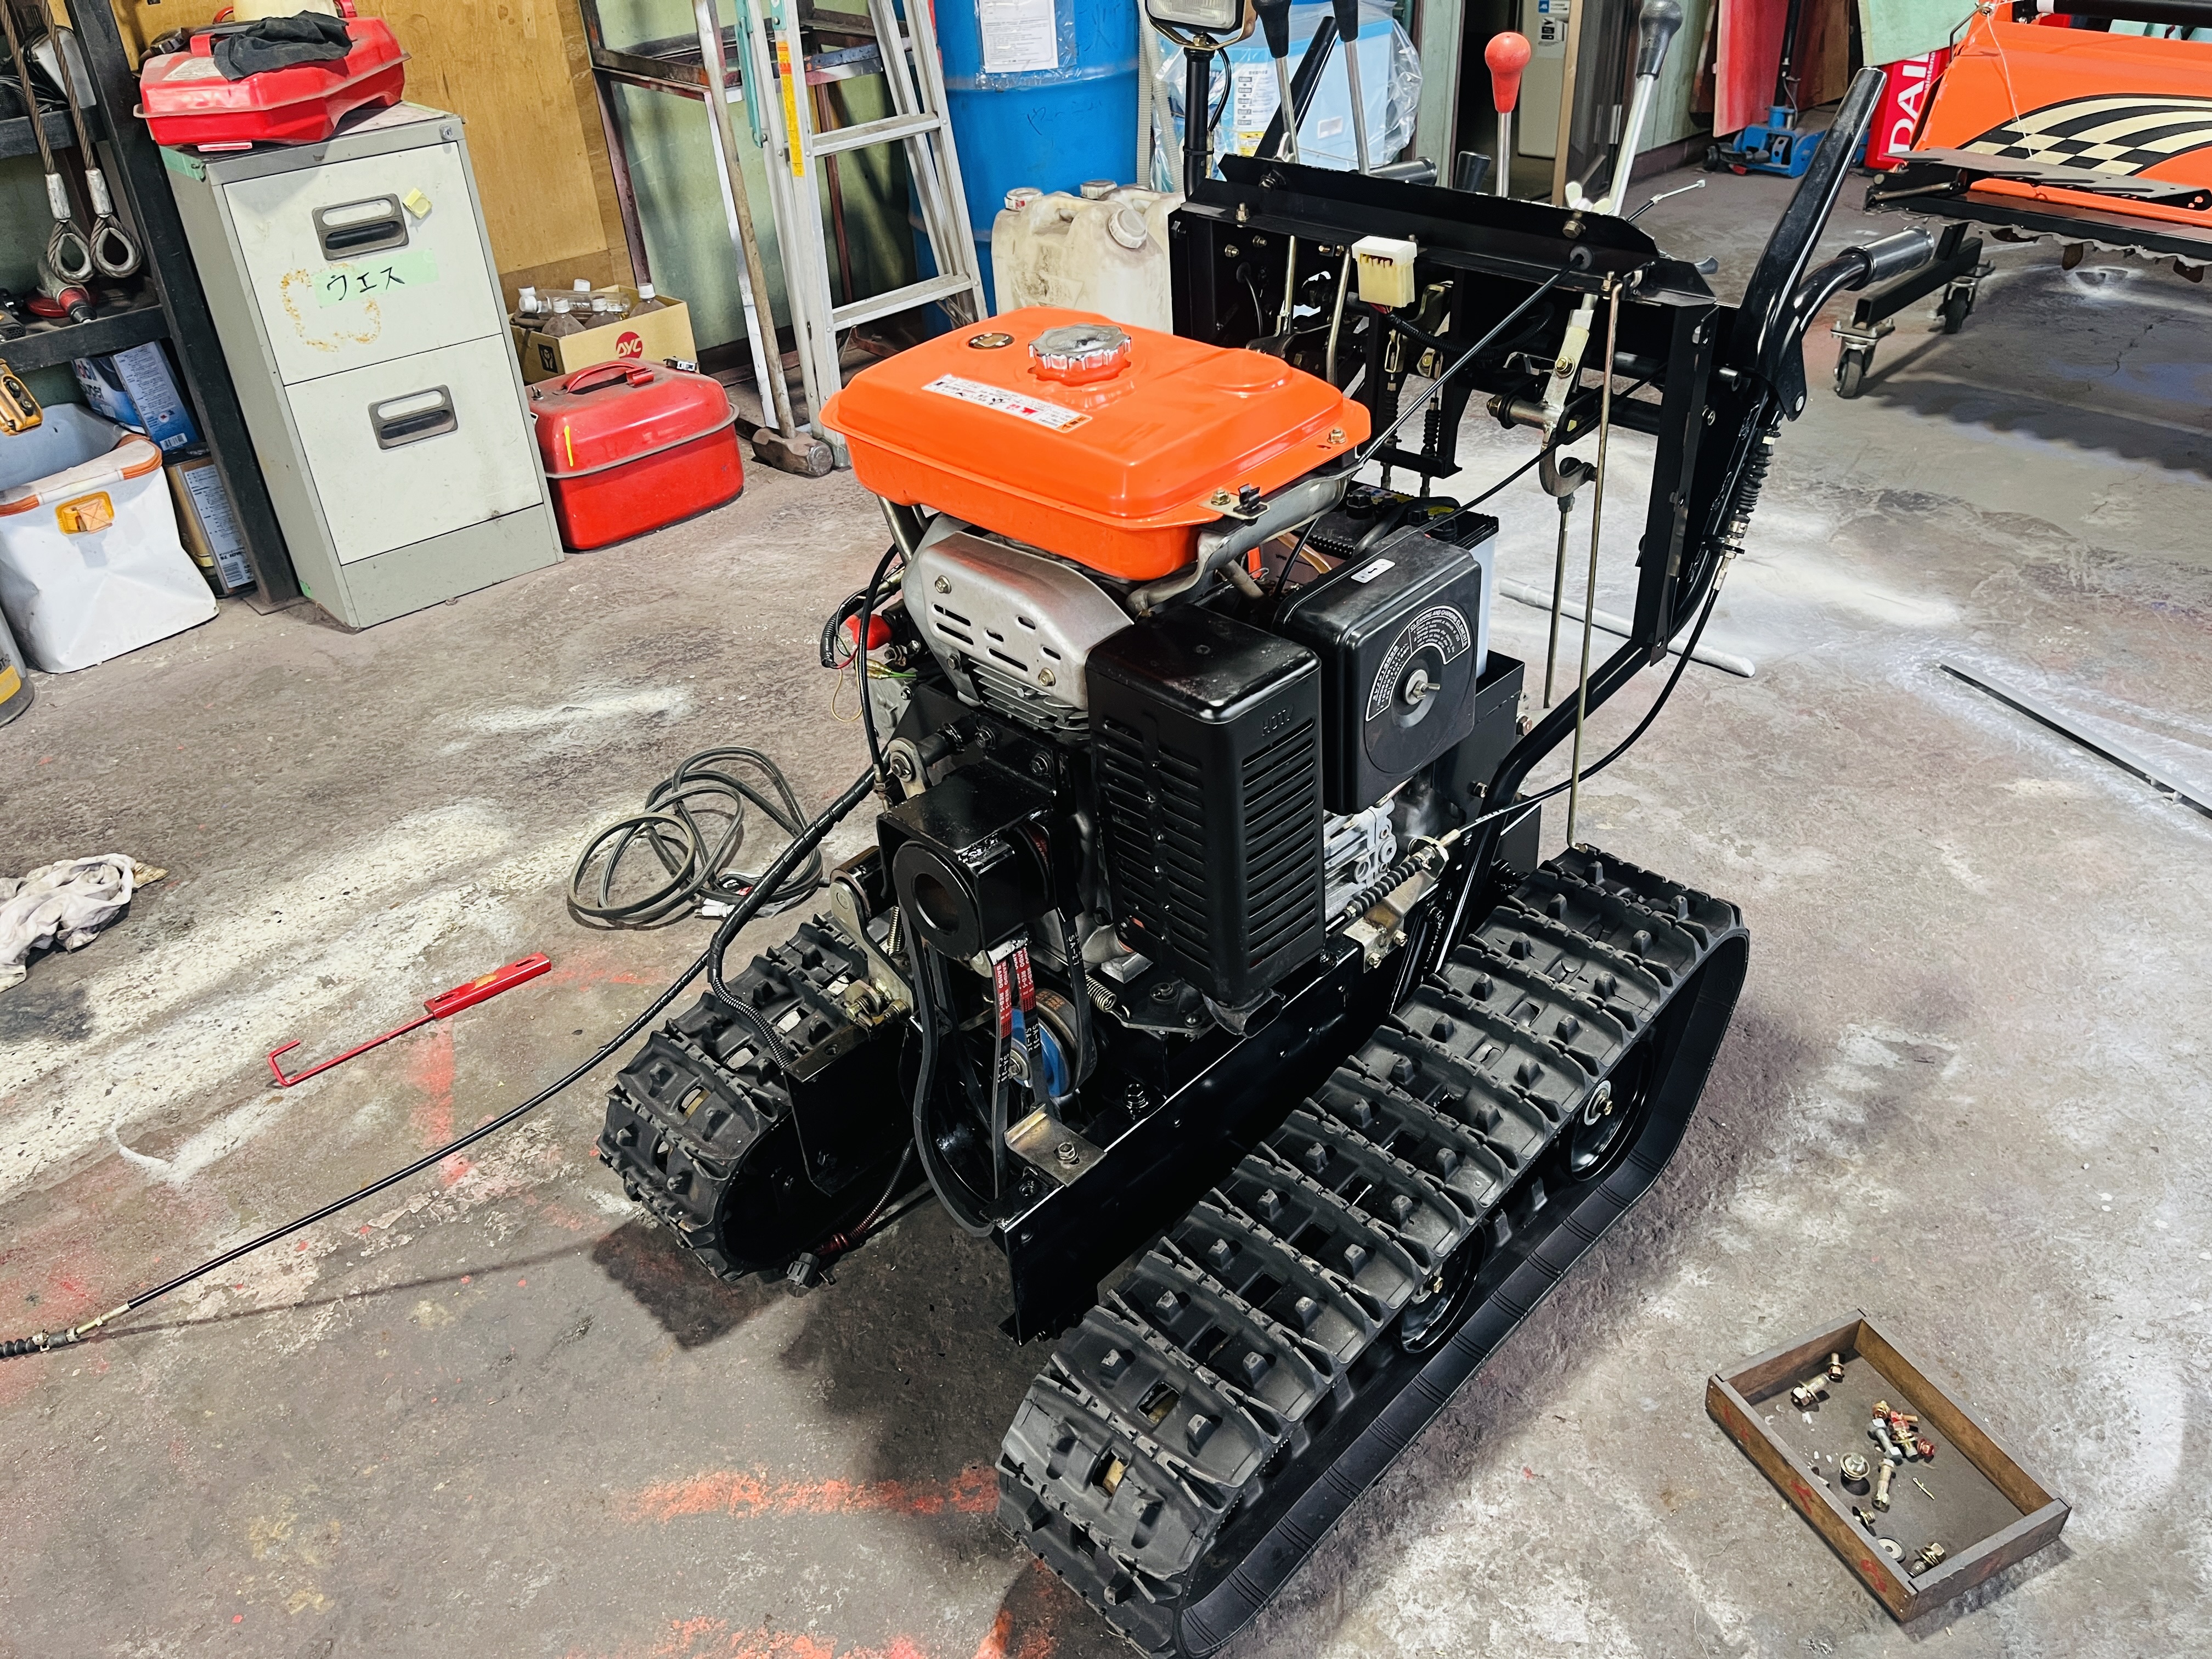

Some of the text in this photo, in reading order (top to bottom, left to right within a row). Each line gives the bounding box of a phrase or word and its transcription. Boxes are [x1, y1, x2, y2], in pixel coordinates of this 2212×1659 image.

[327, 267, 405, 301] ウエス
[1068, 936, 1080, 966] SA-27
